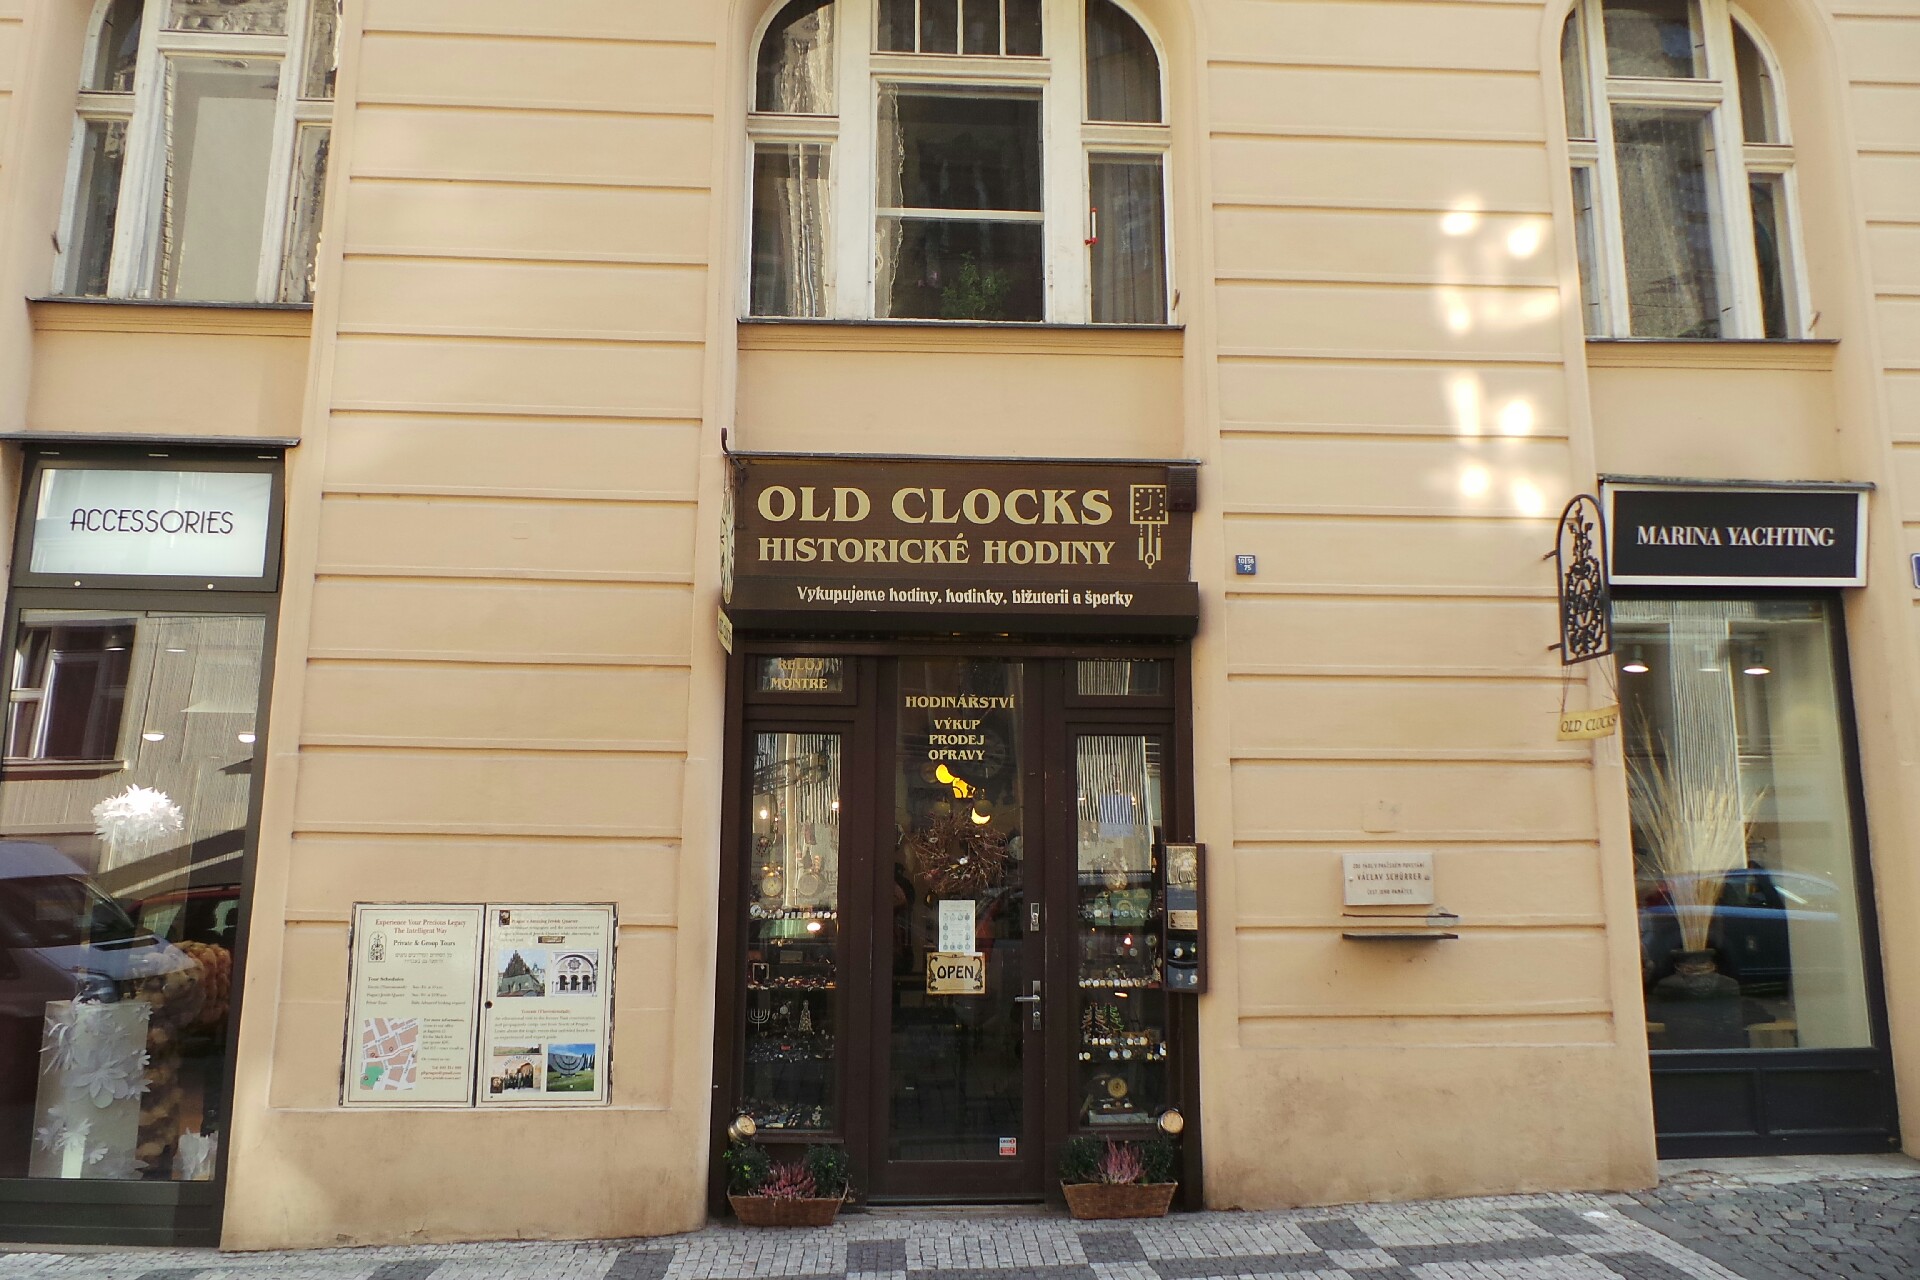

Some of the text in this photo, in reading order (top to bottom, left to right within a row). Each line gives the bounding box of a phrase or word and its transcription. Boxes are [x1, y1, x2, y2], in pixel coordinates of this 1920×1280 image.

[757, 485, 1113, 526] OLD CLOCKS
[70, 508, 234, 534] ACCESSORIES
[1636, 525, 1836, 547] MARINA YACHTING
[757, 532, 1116, 565] HISTORICKÉ HODINY
[796, 584, 1134, 608] Vykupujeme hodiny, hodinky, bižuterii a šperky
[777, 659, 824, 671] RELOJ
[771, 677, 828, 689] MONTRE
[905, 693, 1015, 709] HODINÁŘSTVÍ
[933, 716, 981, 730] VÝKUP
[1560, 719, 1582, 733] OLD
[929, 734, 985, 746] PRODEJ
[928, 749, 985, 761] OPRAVY
[1357, 871, 1383, 881] VÁCLAV
[375, 918, 466, 928] Experience Your Precious Legacy
[406, 928, 435, 936] Intelligent
[421, 939, 439, 948] Group
[936, 965, 974, 979] OPEN
